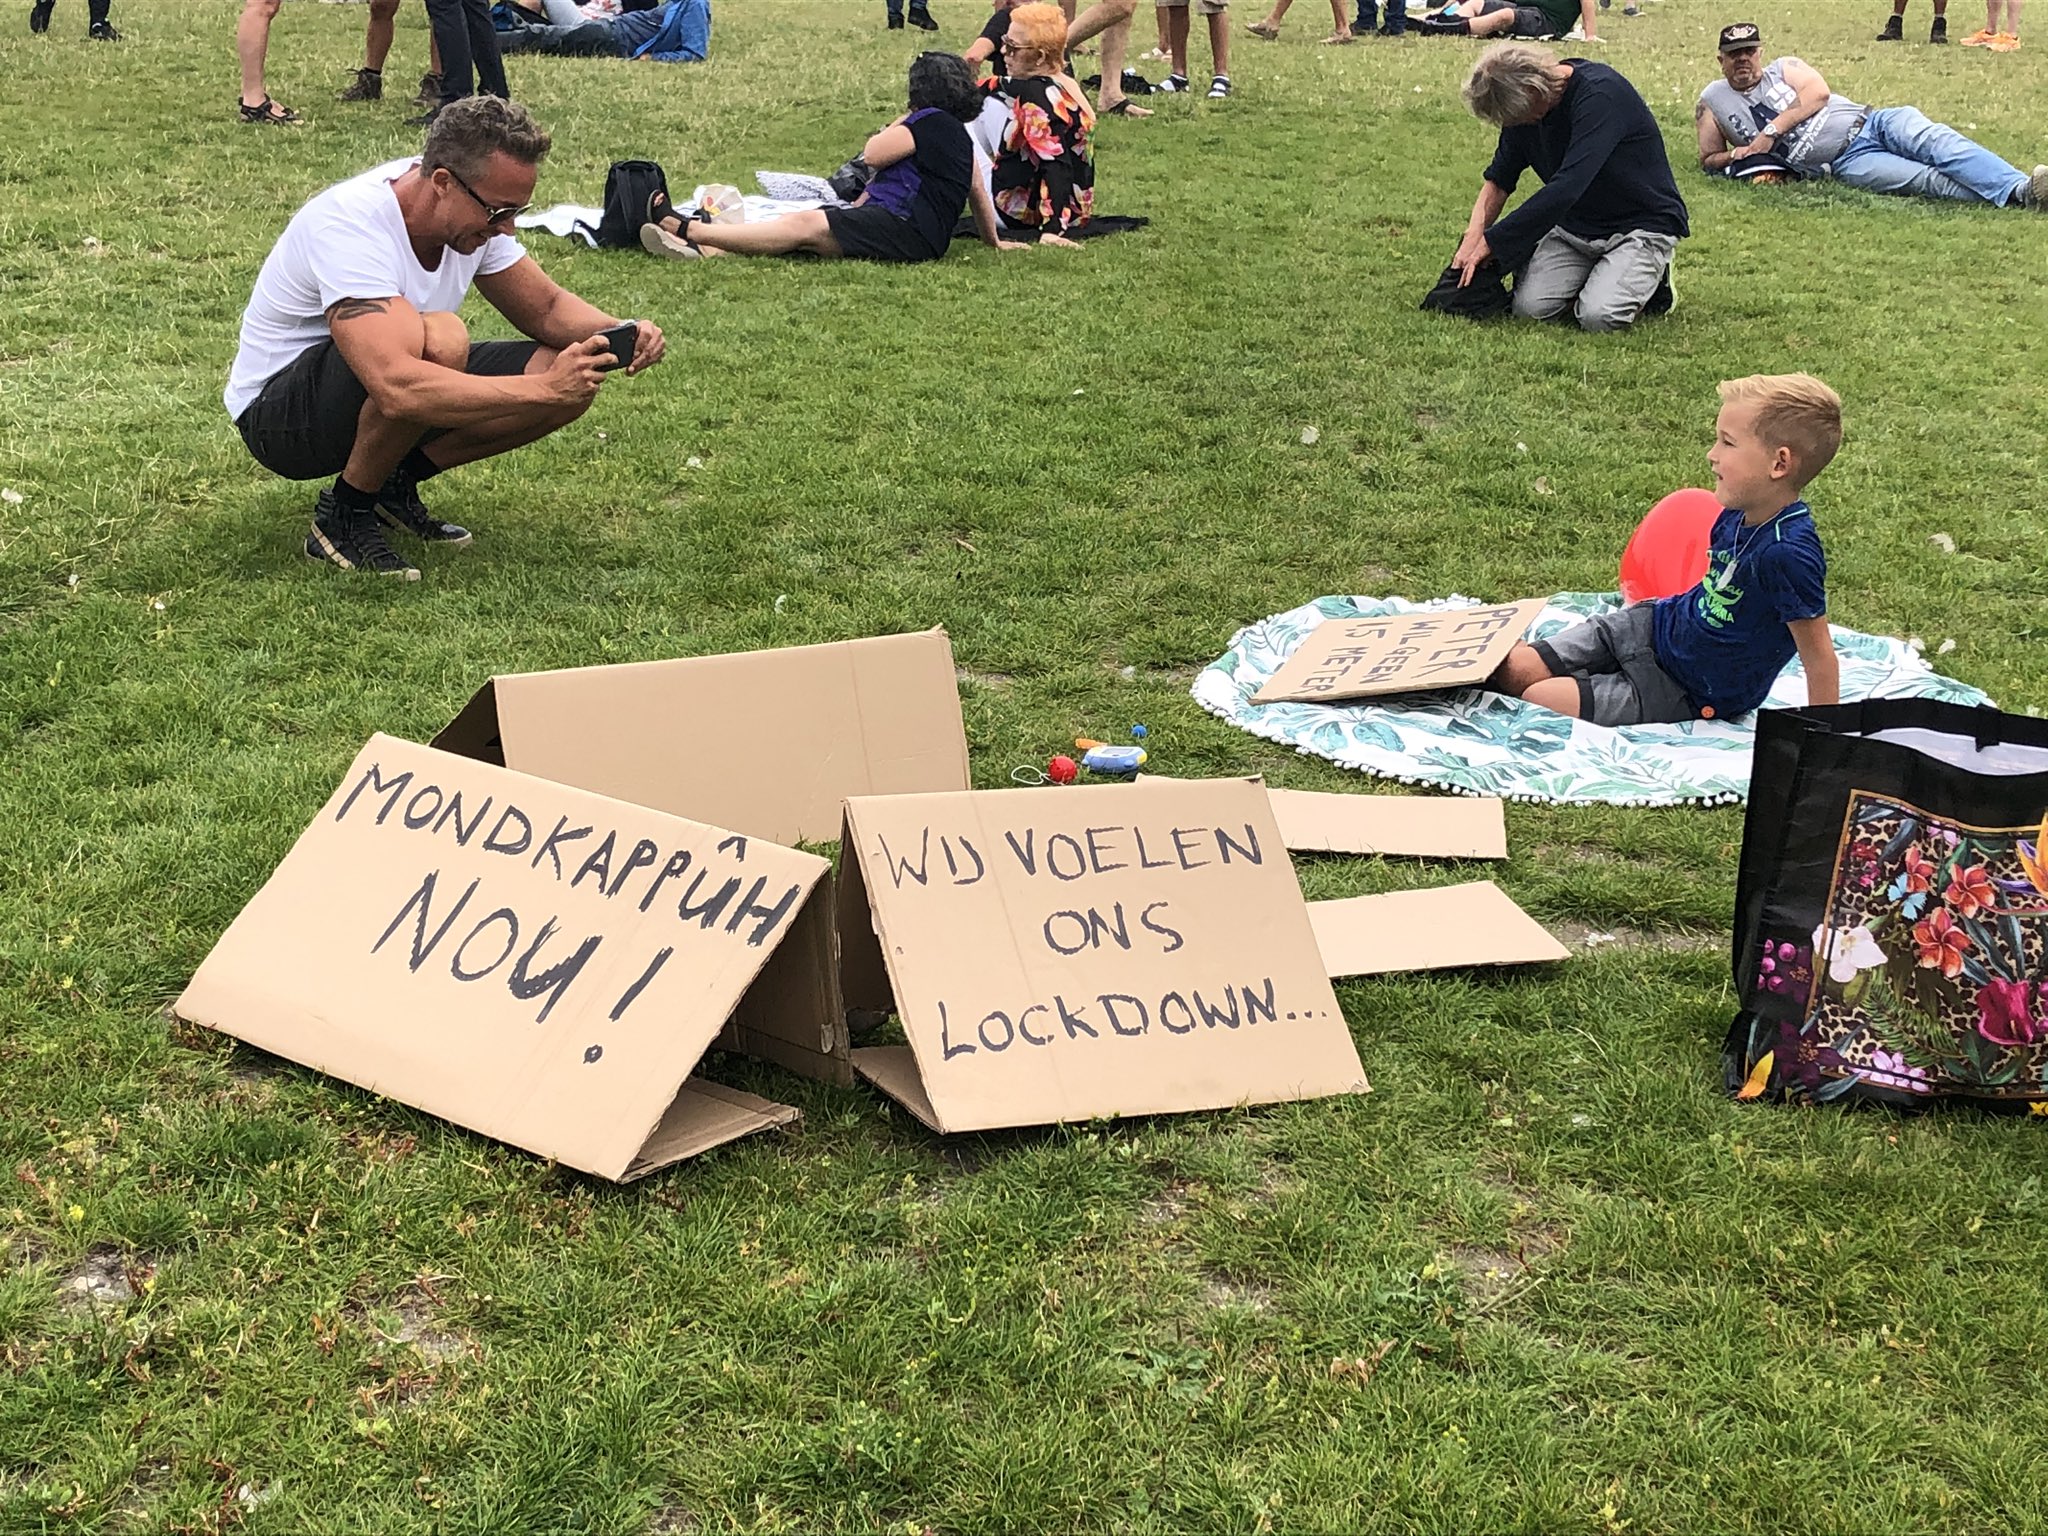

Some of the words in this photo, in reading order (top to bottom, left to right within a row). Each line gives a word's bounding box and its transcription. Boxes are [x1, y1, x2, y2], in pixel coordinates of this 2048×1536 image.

[1399, 619, 1444, 645] WIL
[1411, 606, 1519, 679] PETER
[1290, 646, 1368, 695] METER
[1359, 646, 1420, 685] GEEN
[335, 763, 801, 947] MONDKAPPÛH
[878, 826, 984, 888] WIJ
[1006, 824, 1262, 881] VOELEN
[1044, 902, 1183, 955] ONS
[938, 978, 1326, 1061] LOCKDOWN...
